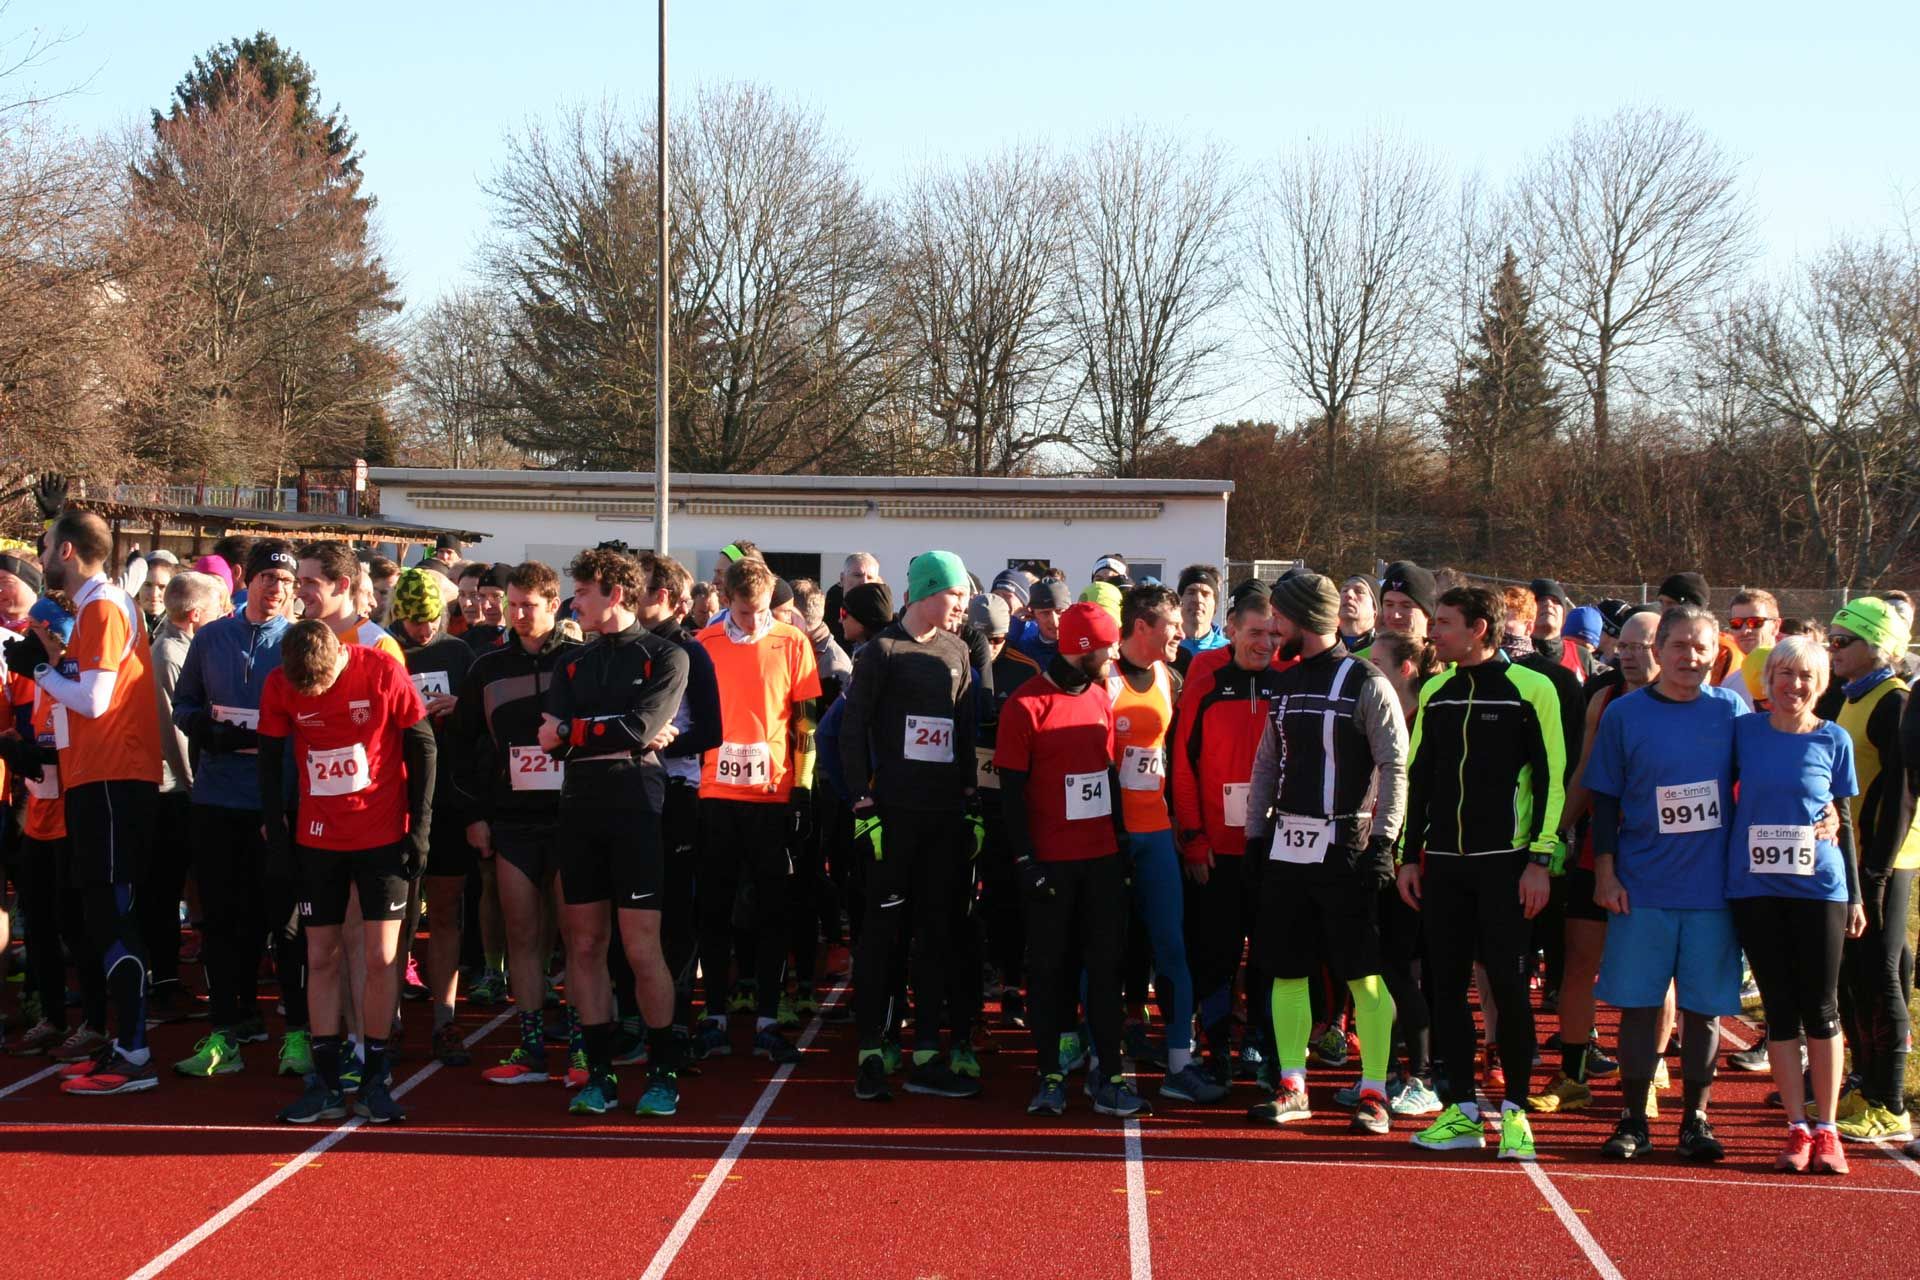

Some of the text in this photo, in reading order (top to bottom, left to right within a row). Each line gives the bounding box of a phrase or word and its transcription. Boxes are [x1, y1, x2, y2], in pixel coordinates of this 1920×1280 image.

[915, 728, 950, 747] 241
[315, 759, 359, 780] 240
[519, 755, 560, 773] 221
[719, 760, 765, 777] 9911
[1137, 757, 1159, 774] 50
[1081, 781, 1102, 801] 54
[1661, 800, 1719, 825] 9914
[310, 820, 323, 836] LH
[1283, 829, 1320, 848] 137
[1752, 846, 1812, 866] 9915
